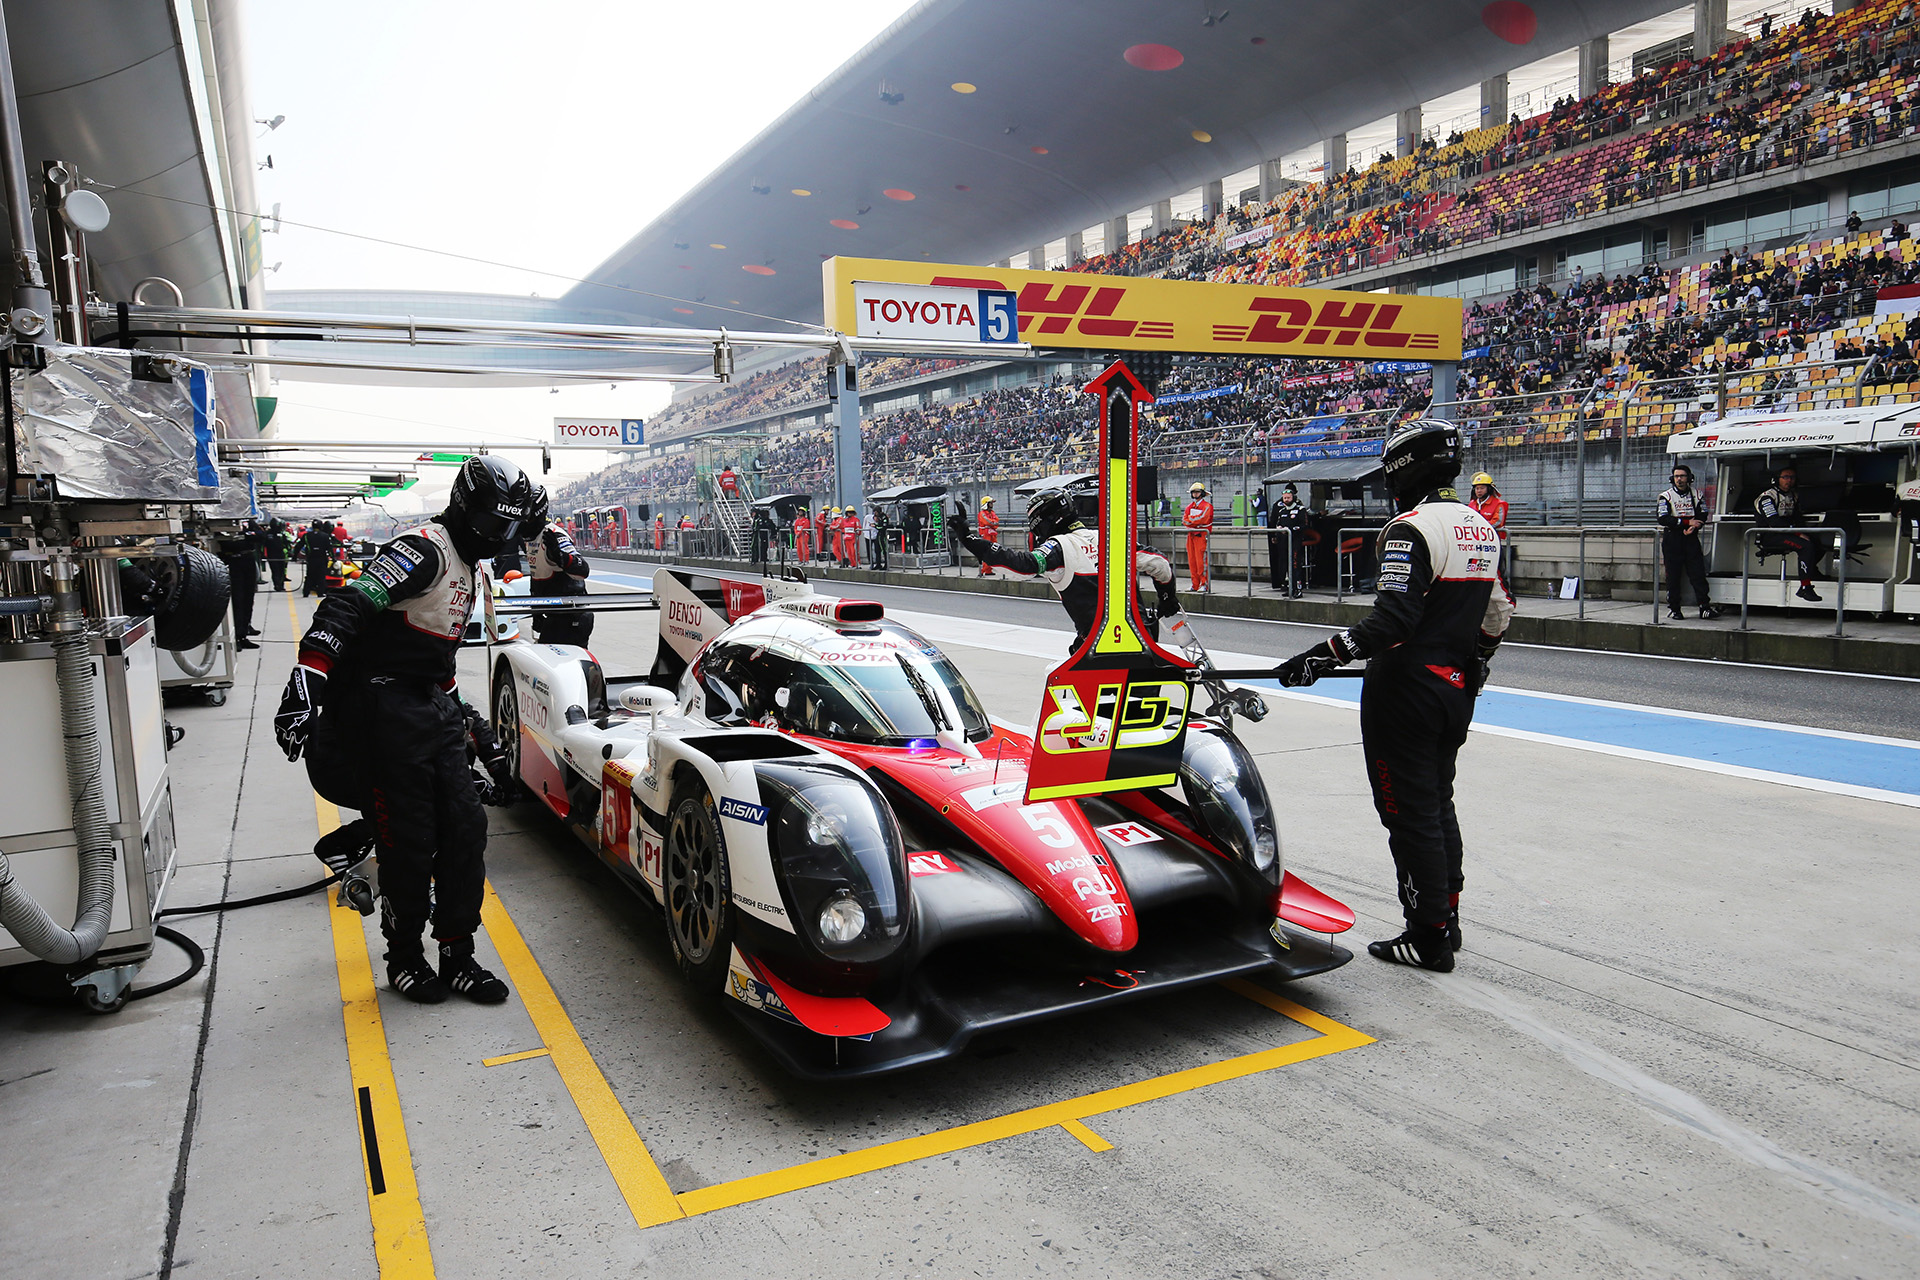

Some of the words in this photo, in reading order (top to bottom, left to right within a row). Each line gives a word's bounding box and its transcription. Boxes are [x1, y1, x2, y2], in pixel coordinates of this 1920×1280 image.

[863, 299, 976, 326] TOYOTA
[987, 295, 1010, 341] 5
[1246, 297, 1413, 349] DHL
[558, 425, 619, 437] TOYOTA
[626, 422, 640, 444] 6
[1694, 439, 1716, 448] GR
[1718, 438, 1757, 446] TOYOTA
[1759, 436, 1796, 444] GAZOO
[1798, 433, 1835, 442] Racing
[1385, 453, 1414, 473] uvex
[497, 503, 523, 516] uvex
[1454, 526, 1494, 542] DENSO
[389, 552, 412, 569] AISIN
[396, 543, 422, 561] JTEKT
[730, 588, 742, 612] HY
[669, 600, 702, 627] DENSO
[308, 630, 333, 644] obil
[669, 625, 685, 637] TOYOTA
[685, 630, 704, 642] HYBRID
[819, 652, 893, 662] TOYOTA
[521, 691, 548, 730] DENSO
[628, 696, 644, 706] Mobil
[1098, 730, 1109, 743] 5
[1376, 760, 1399, 814] DENSO
[606, 784, 616, 844] 5
[722, 800, 764, 822] AISIN
[1017, 801, 1075, 848] 5
[1108, 825, 1151, 842] P1
[645, 840, 661, 878] P1
[711, 818, 726, 887] MICHELIN
[908, 854, 949, 873] HY
[1045, 854, 1094, 876] Mobil
[757, 901, 785, 915] ELECTRIC
[1086, 903, 1128, 923] ZENT
